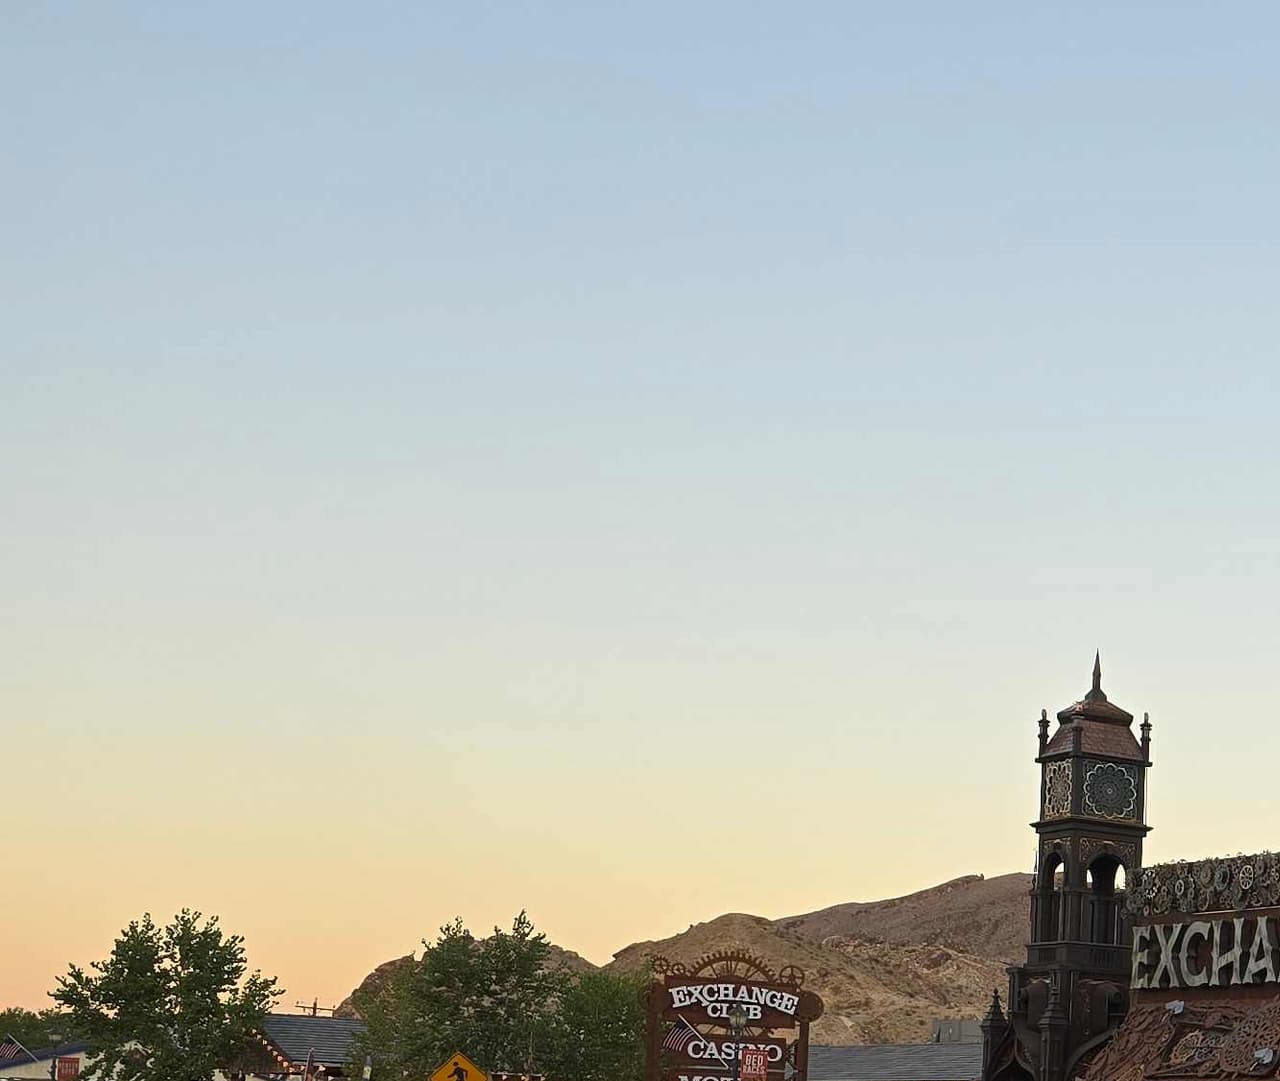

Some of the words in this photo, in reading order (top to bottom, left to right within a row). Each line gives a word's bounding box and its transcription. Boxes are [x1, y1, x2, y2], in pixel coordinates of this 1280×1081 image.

[668, 983, 800, 1015] EXCHANGE
[687, 1041, 783, 1062] CASIO
[745, 1054, 764, 1066] BED
[743, 1065, 766, 1075] RACES
